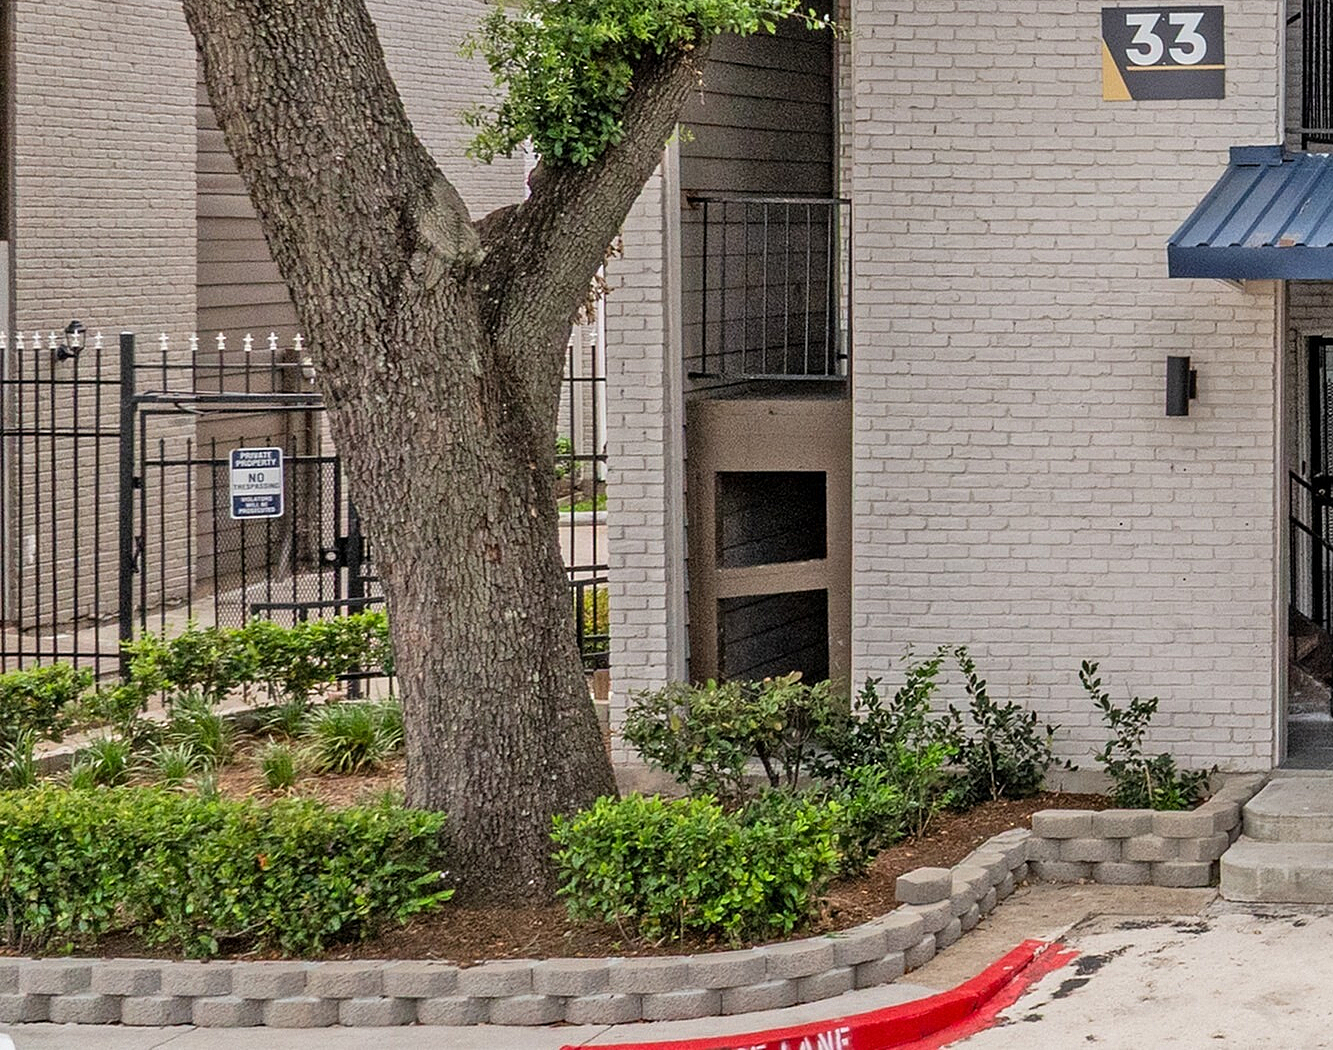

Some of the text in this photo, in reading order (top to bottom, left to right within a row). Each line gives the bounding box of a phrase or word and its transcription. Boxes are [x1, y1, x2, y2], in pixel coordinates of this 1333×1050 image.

[1126, 13, 1207, 66] 33
[235, 459, 276, 467] PROPERTY
[249, 473, 264, 482] NO
